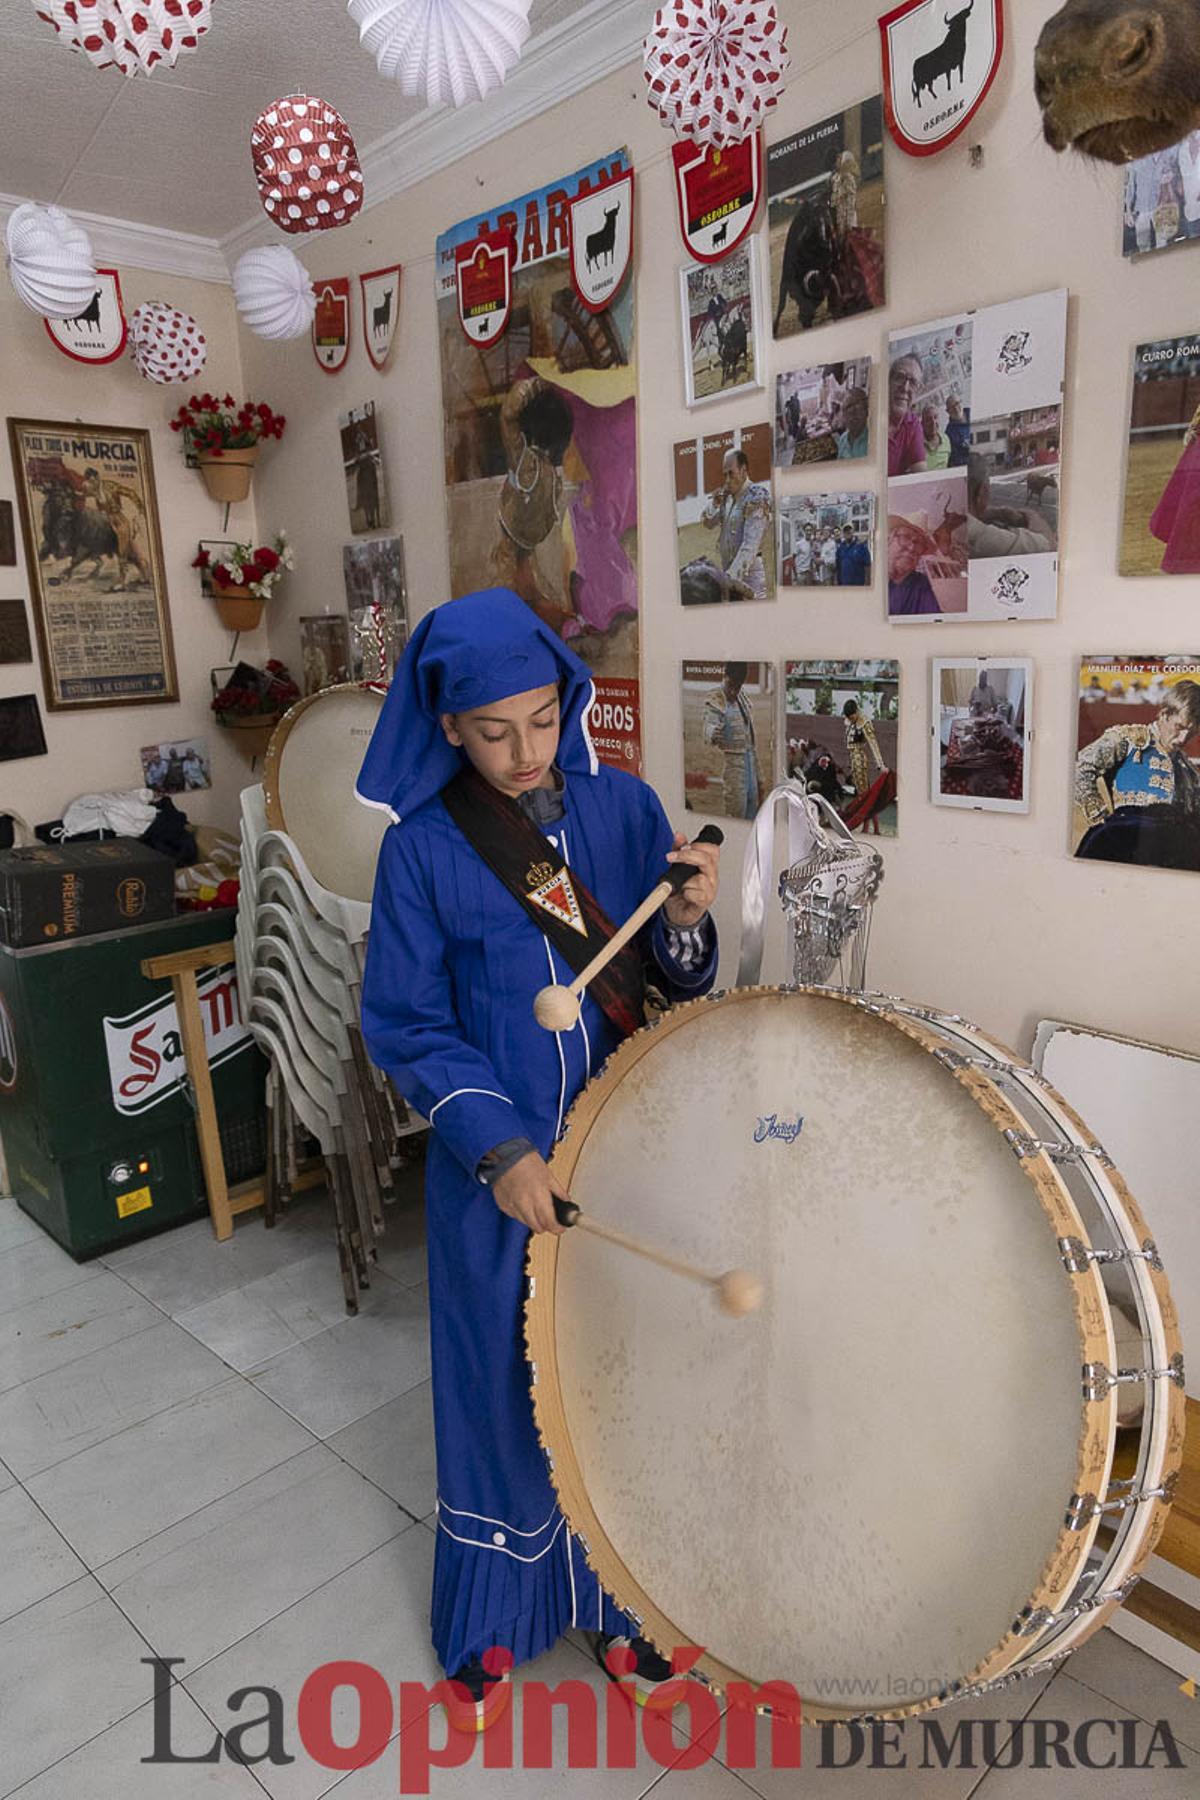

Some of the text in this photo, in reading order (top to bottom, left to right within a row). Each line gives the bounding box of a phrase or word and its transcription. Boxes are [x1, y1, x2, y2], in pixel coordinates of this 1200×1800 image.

[923, 99, 965, 131] OSBORNE
[808, 133, 815, 144] LA
[701, 198, 740, 226] OSBORNE
[1142, 349, 1174, 362] CURRO
[71, 440, 136, 461] MURCIA
[1124, 661, 1145, 673] DÍAZ
[592, 703, 634, 732] OROS
[537, 878, 561, 896] MURCIA
[63, 873, 77, 934] PREMIUM
[119, 1021, 185, 1097] Sa
